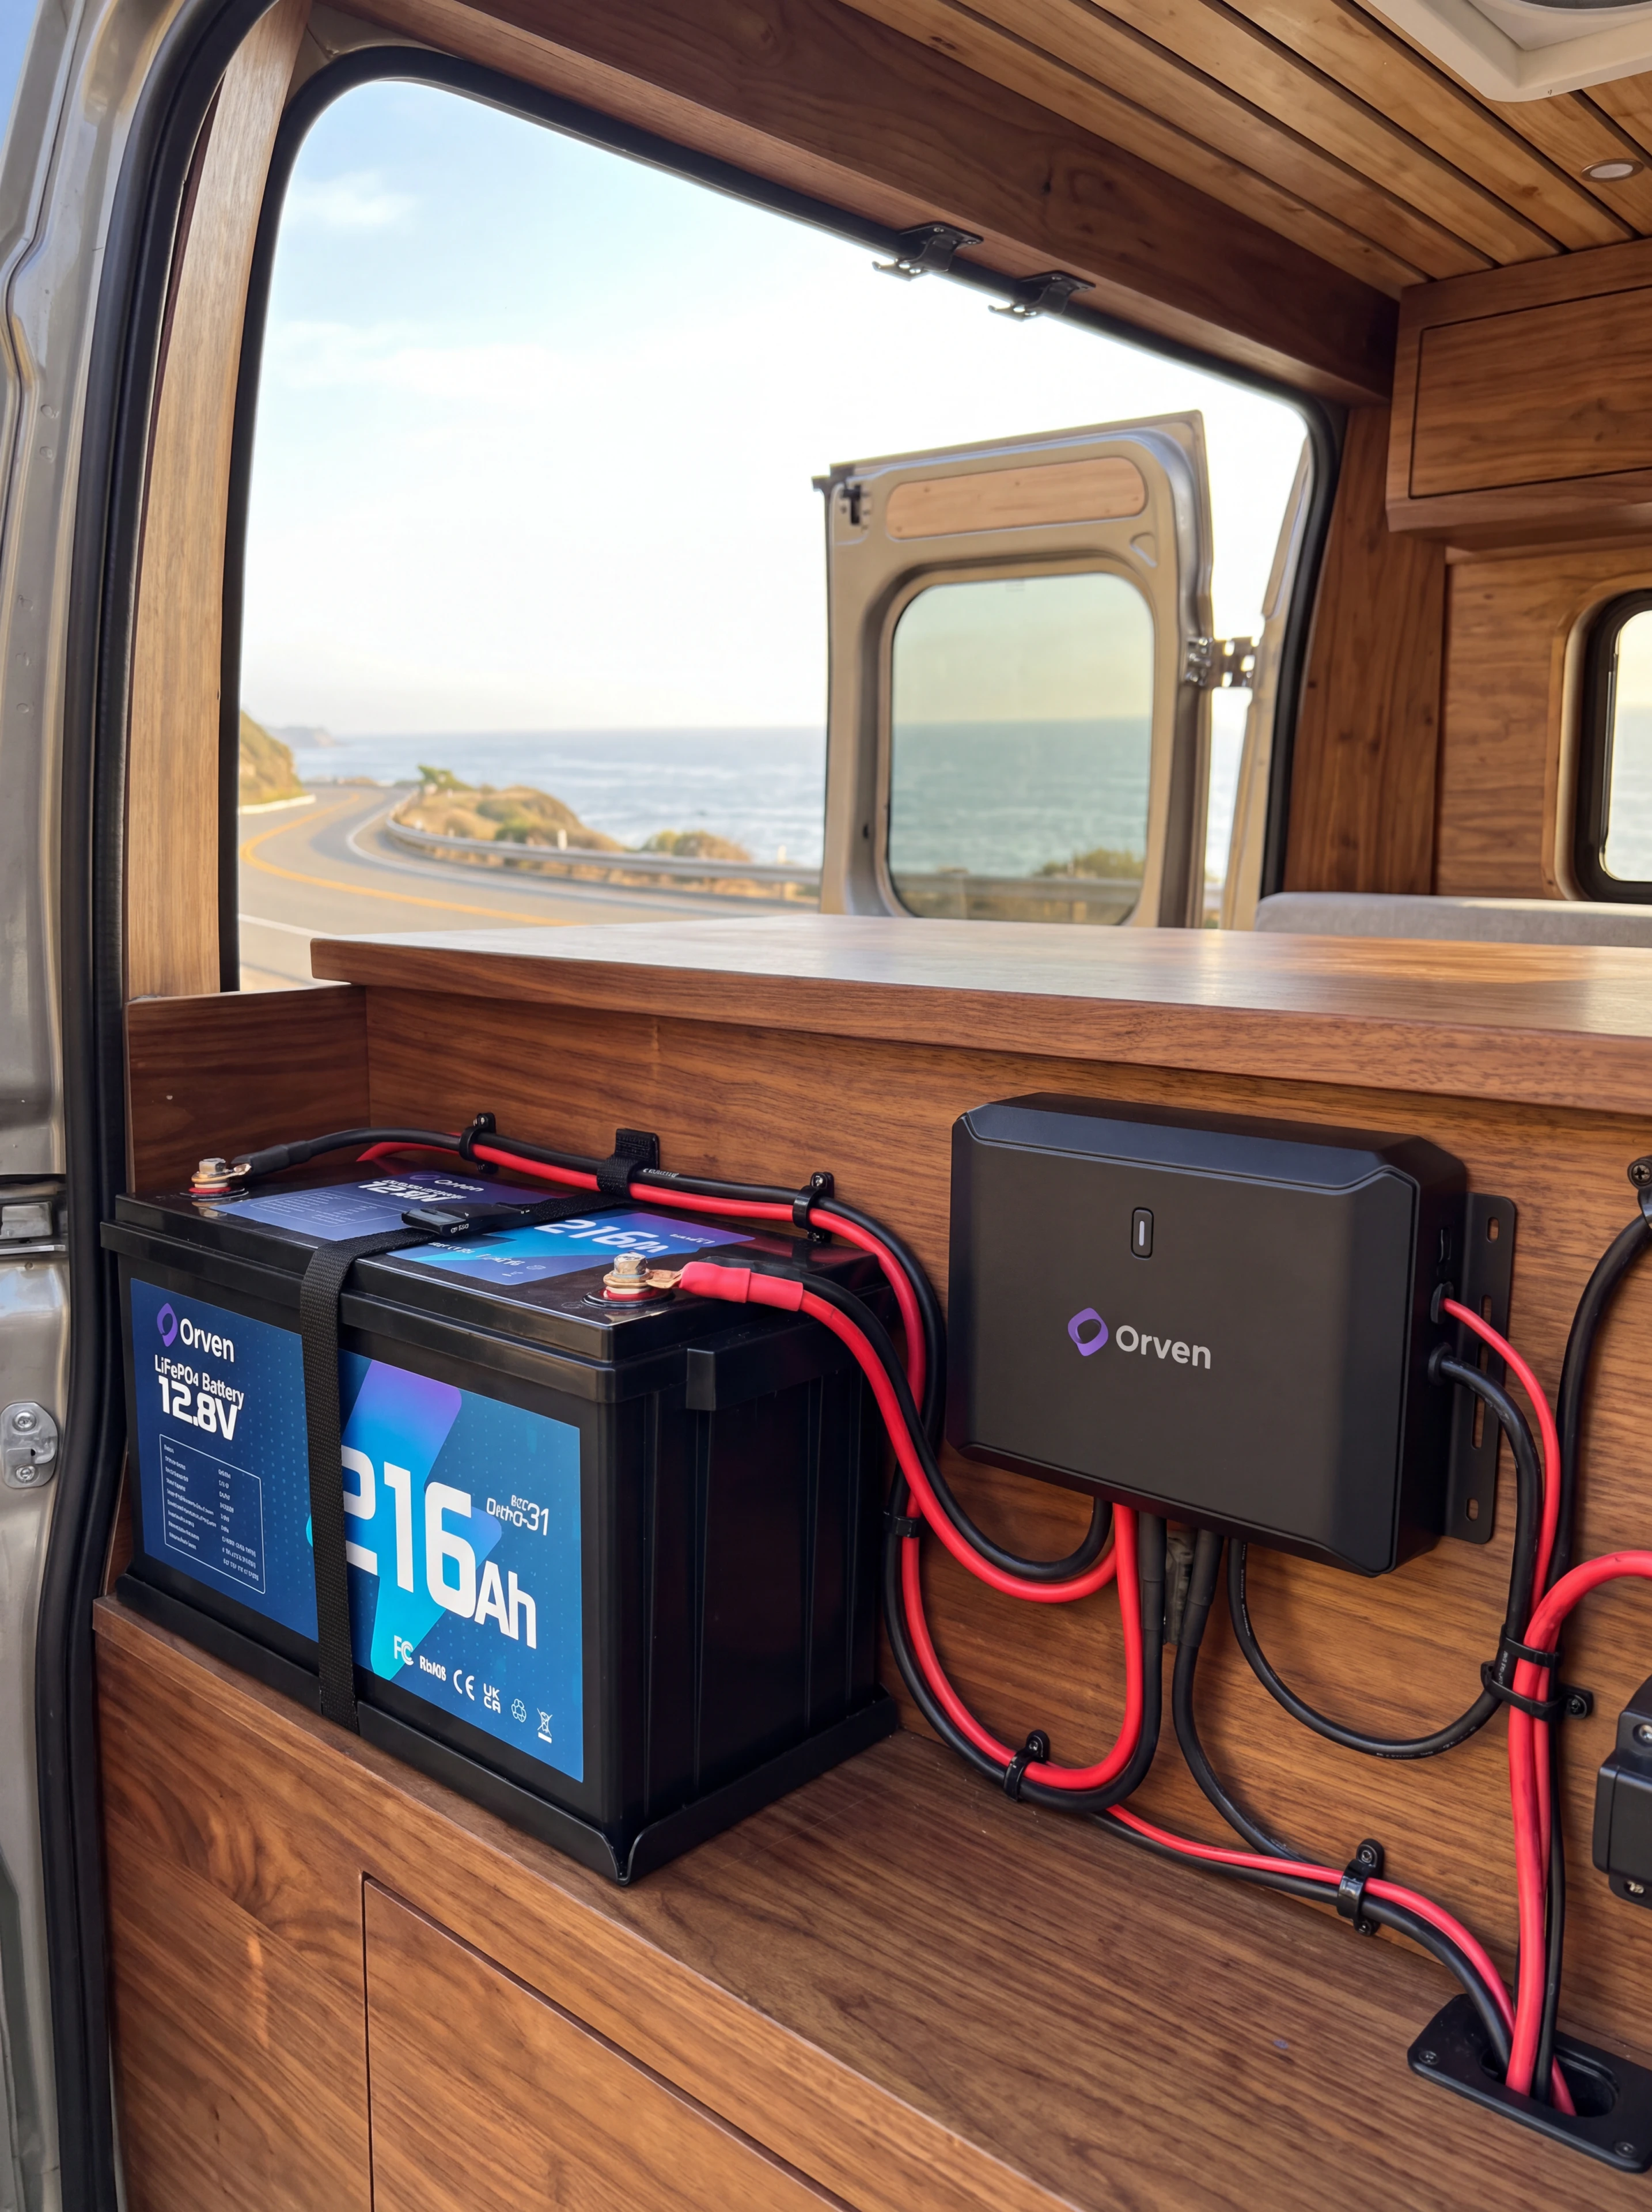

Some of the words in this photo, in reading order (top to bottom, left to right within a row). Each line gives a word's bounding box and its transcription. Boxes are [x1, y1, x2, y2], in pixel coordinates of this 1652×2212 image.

[180, 1318, 235, 1363] Orven
[1115, 1324, 1211, 1369] Orven
[154, 1354, 199, 1387] LiFePO4
[202, 1372, 244, 1411] Battery
[158, 1375, 238, 1441] 12.8V
[453, 1669, 475, 1701] CE
[483, 1683, 500, 1701] UK
[483, 1695, 501, 1714] CA
